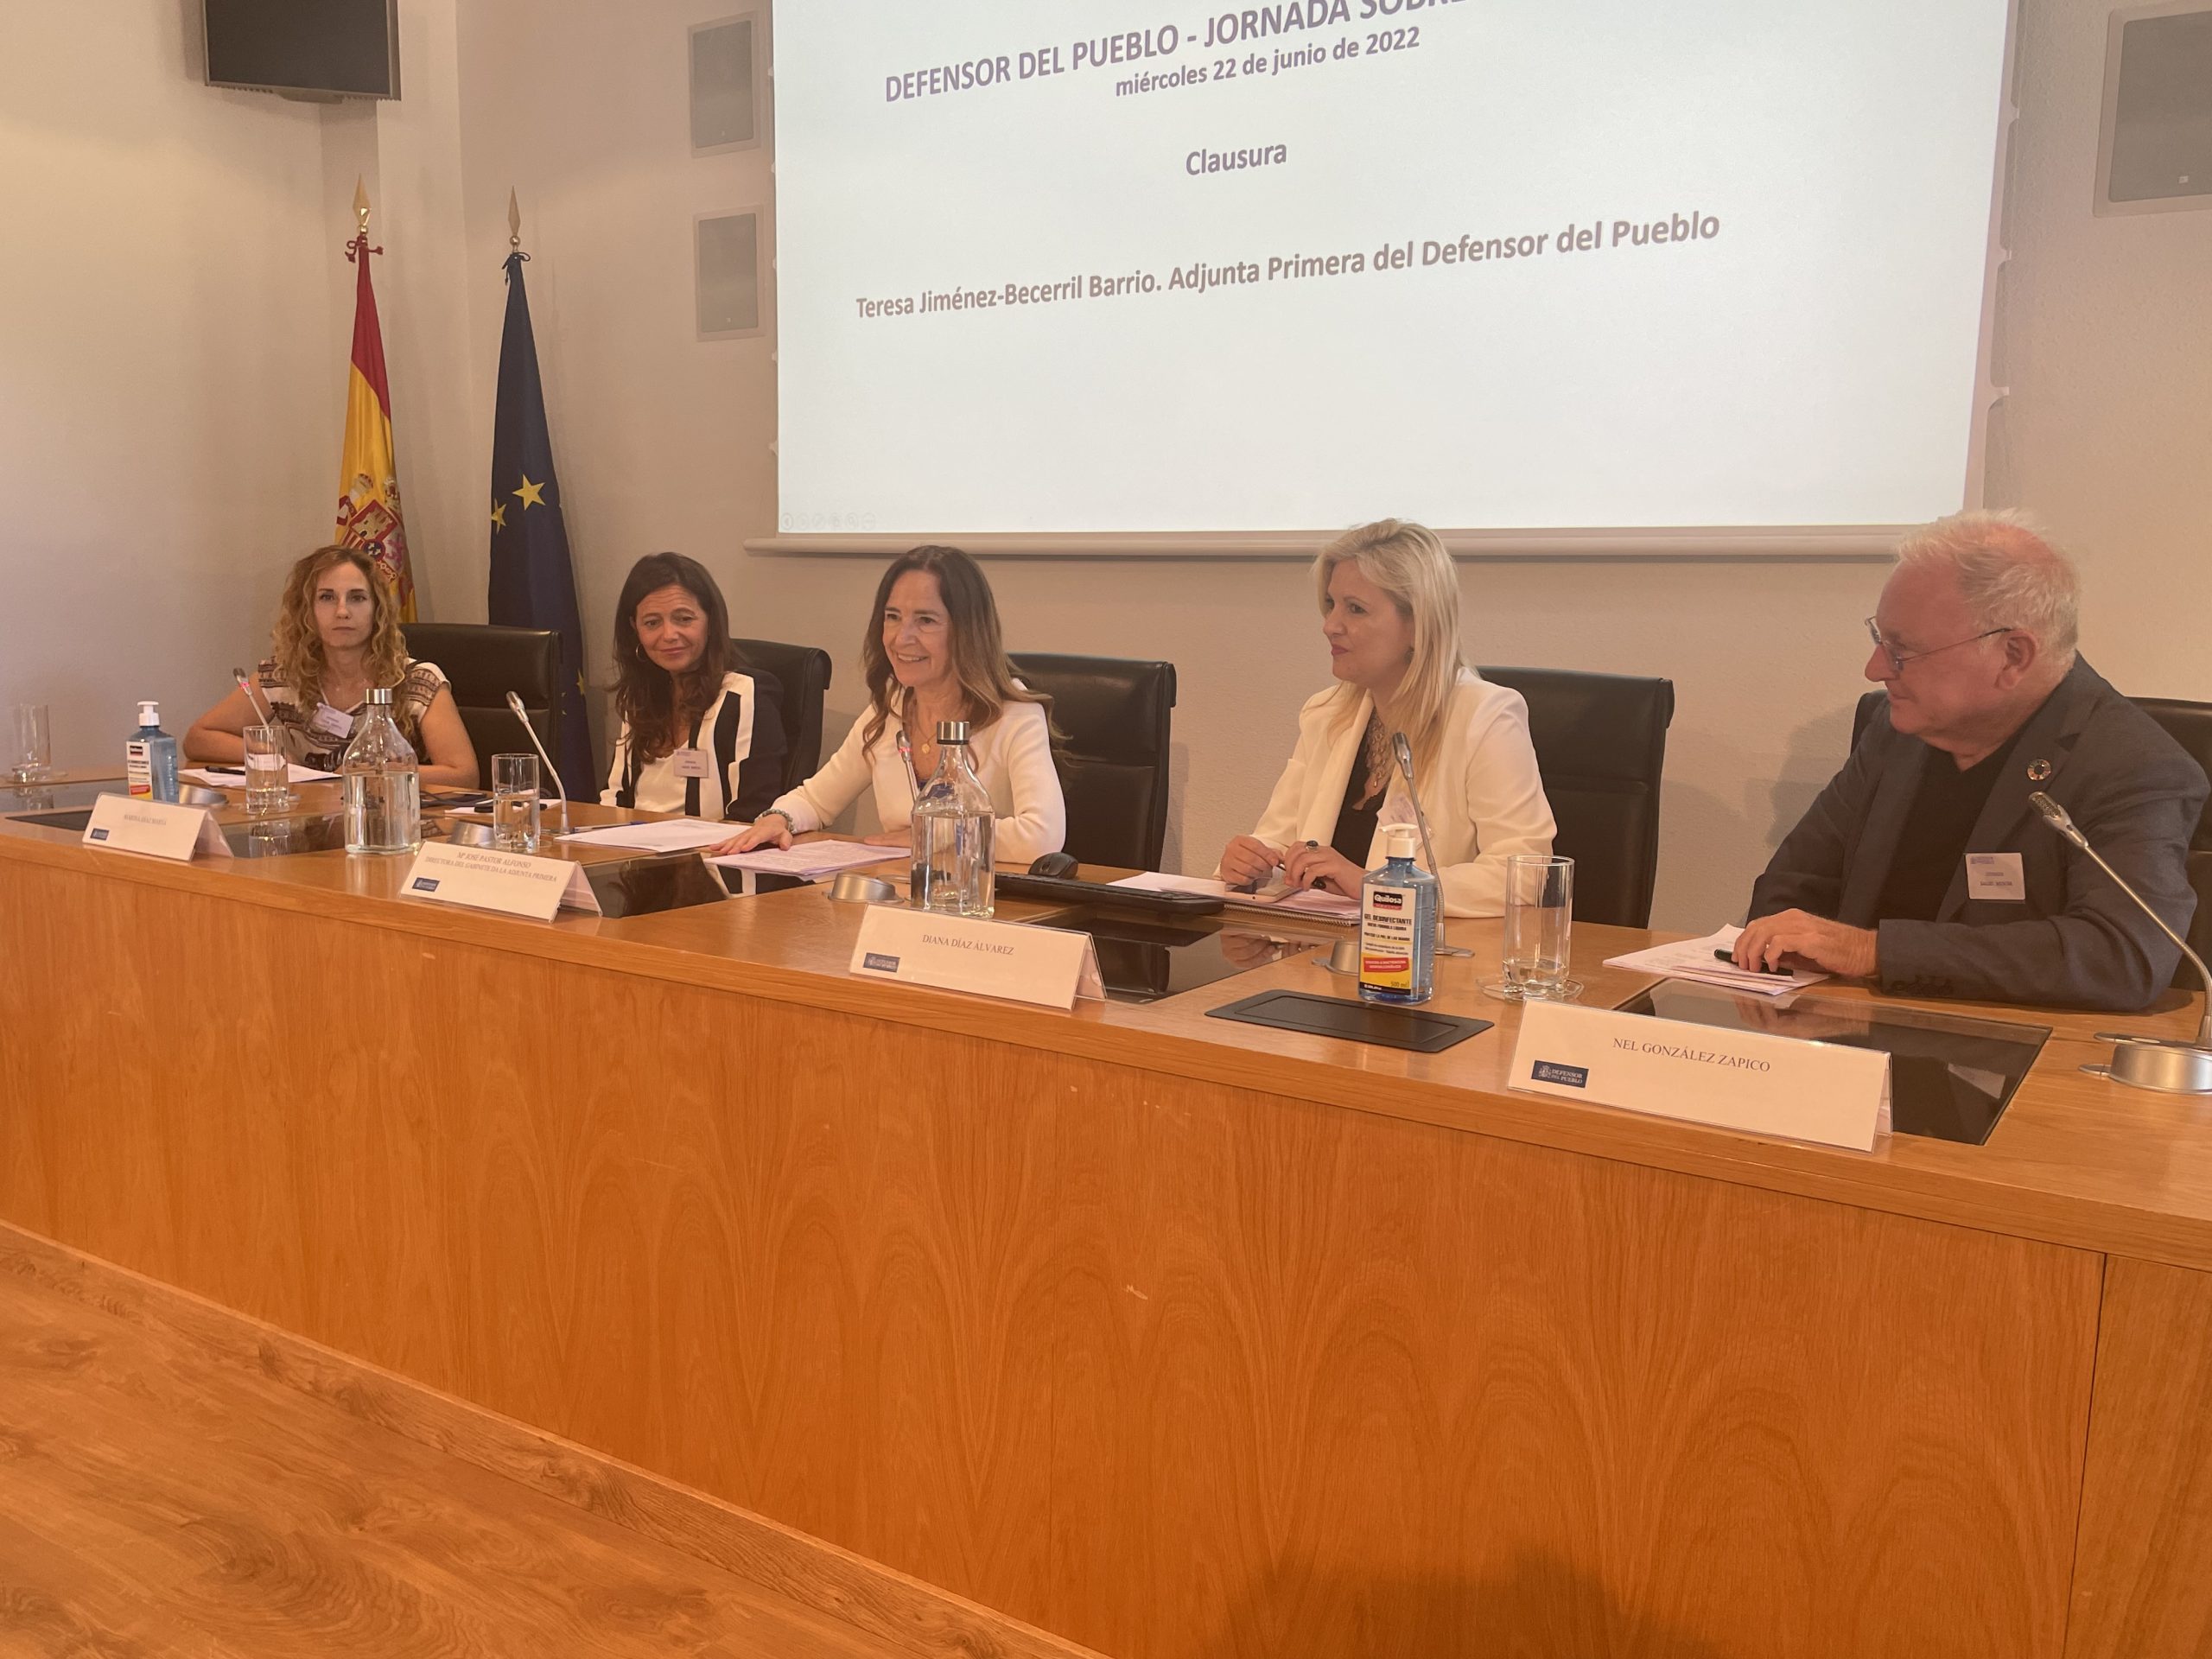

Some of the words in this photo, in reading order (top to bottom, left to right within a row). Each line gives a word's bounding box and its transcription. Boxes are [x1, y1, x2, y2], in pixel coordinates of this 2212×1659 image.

[886, 56, 1011, 102] DEFENSOR
[1019, 47, 1065, 79] DEL
[1073, 24, 1179, 70] PUEBLO
[1204, 0, 1351, 48] JORNADA
[1116, 65, 1208, 97] miércoles
[1213, 58, 1236, 80] 22
[1242, 53, 1268, 75] de
[1272, 42, 1326, 76] junio
[1332, 37, 1359, 60] de
[1366, 26, 1420, 54] 2022
[1185, 144, 1287, 175] Clausura
[856, 296, 914, 319] Teresa
[918, 275, 1083, 314] Jiménez-Becerril
[1089, 270, 1162, 298] Barrio.
[1168, 261, 1260, 294] Adjunta
[1268, 253, 1365, 281] Primera
[1373, 240, 1414, 271] del
[1422, 234, 1548, 266] Defensor
[1556, 220, 1602, 253] del
[1611, 210, 1720, 248] Pueblo
[480, 855, 503, 865] PASTOR
[1374, 893, 1402, 904] Quilosa
[922, 934, 950, 946] DIANA
[950, 938, 973, 950] DÍAZ
[973, 940, 1014, 956] ÁLVAREZ
[1612, 1038, 1638, 1052] NEL
[1642, 1042, 1716, 1064] GONZÁLEZ
[1717, 1054, 1770, 1072] ZAPICO
